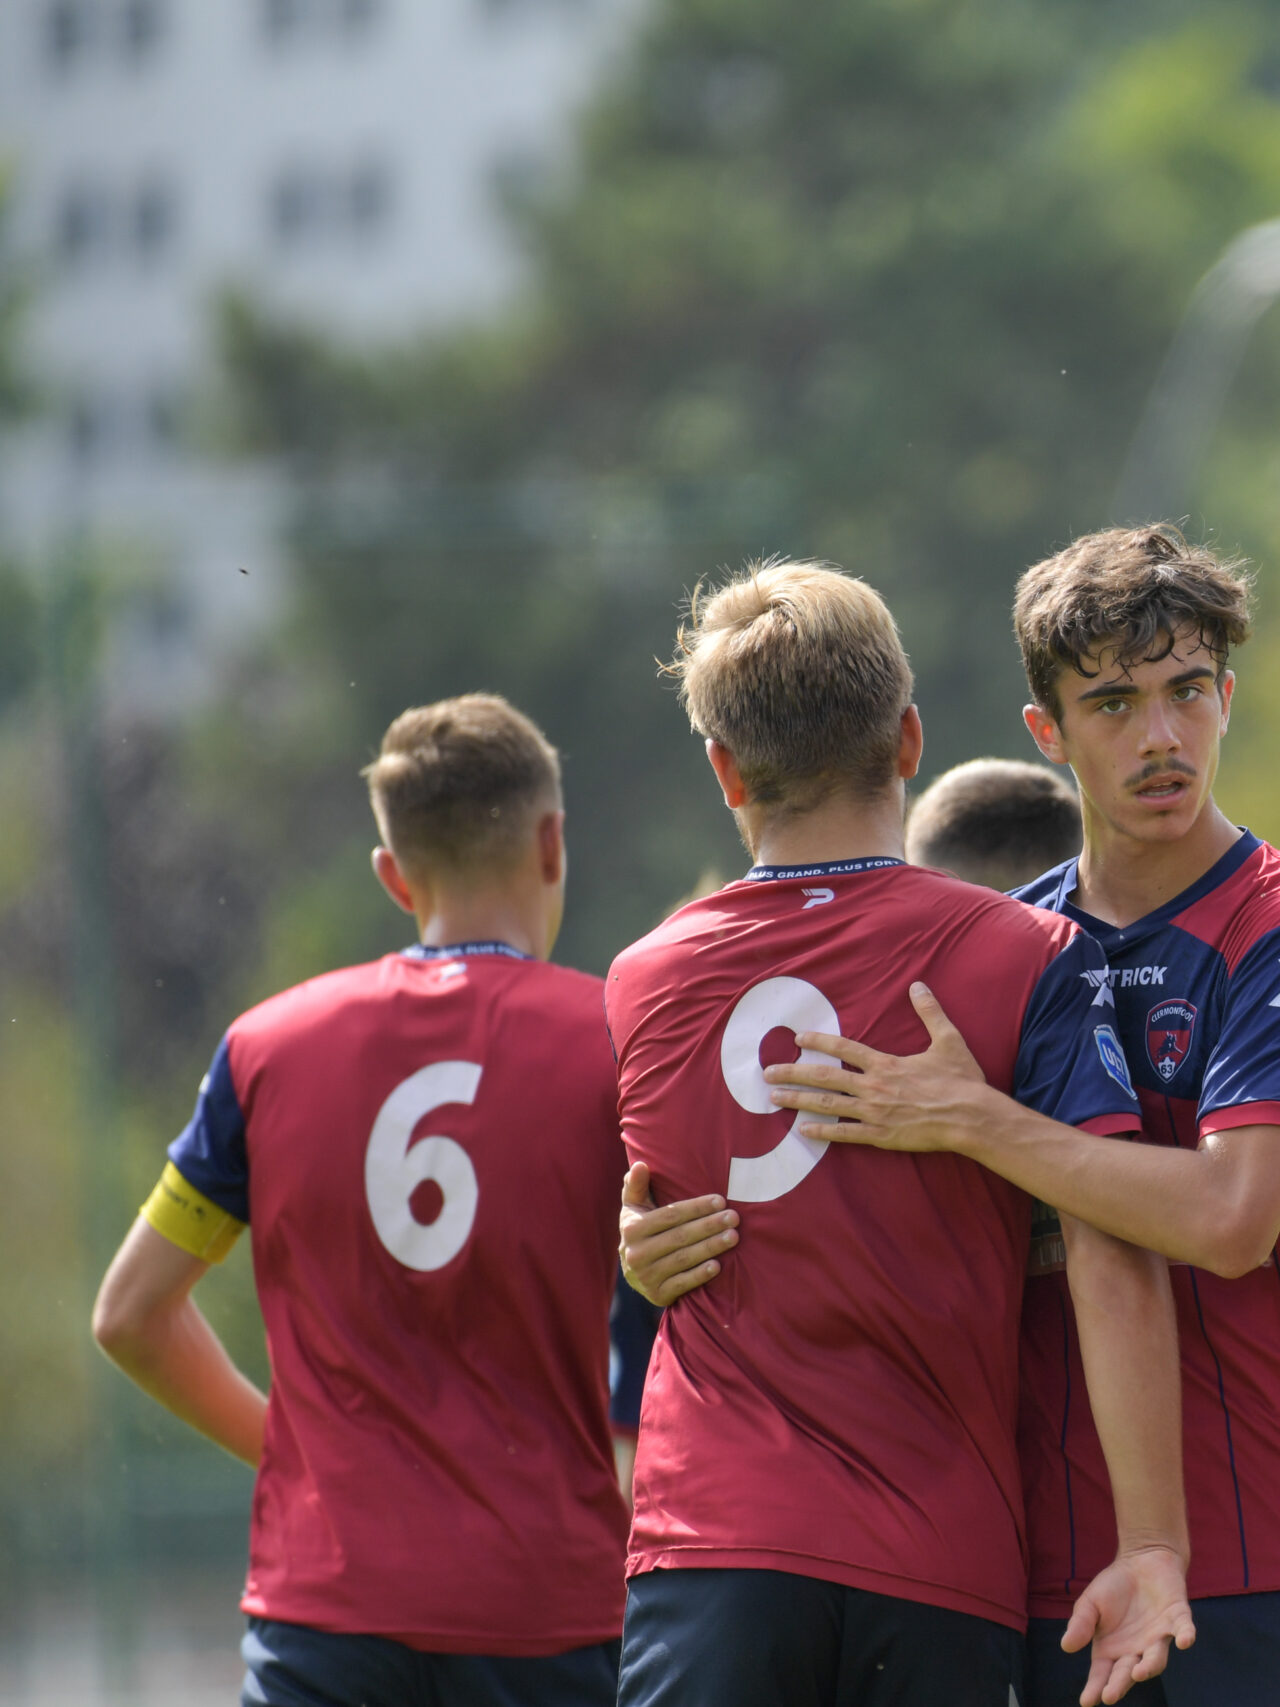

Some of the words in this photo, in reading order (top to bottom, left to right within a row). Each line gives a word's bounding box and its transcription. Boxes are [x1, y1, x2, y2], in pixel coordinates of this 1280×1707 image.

[828, 862, 863, 874] PLUS
[721, 976, 842, 1204] 9
[1160, 1063, 1173, 1075] 63
[365, 1060, 483, 1271] 6
